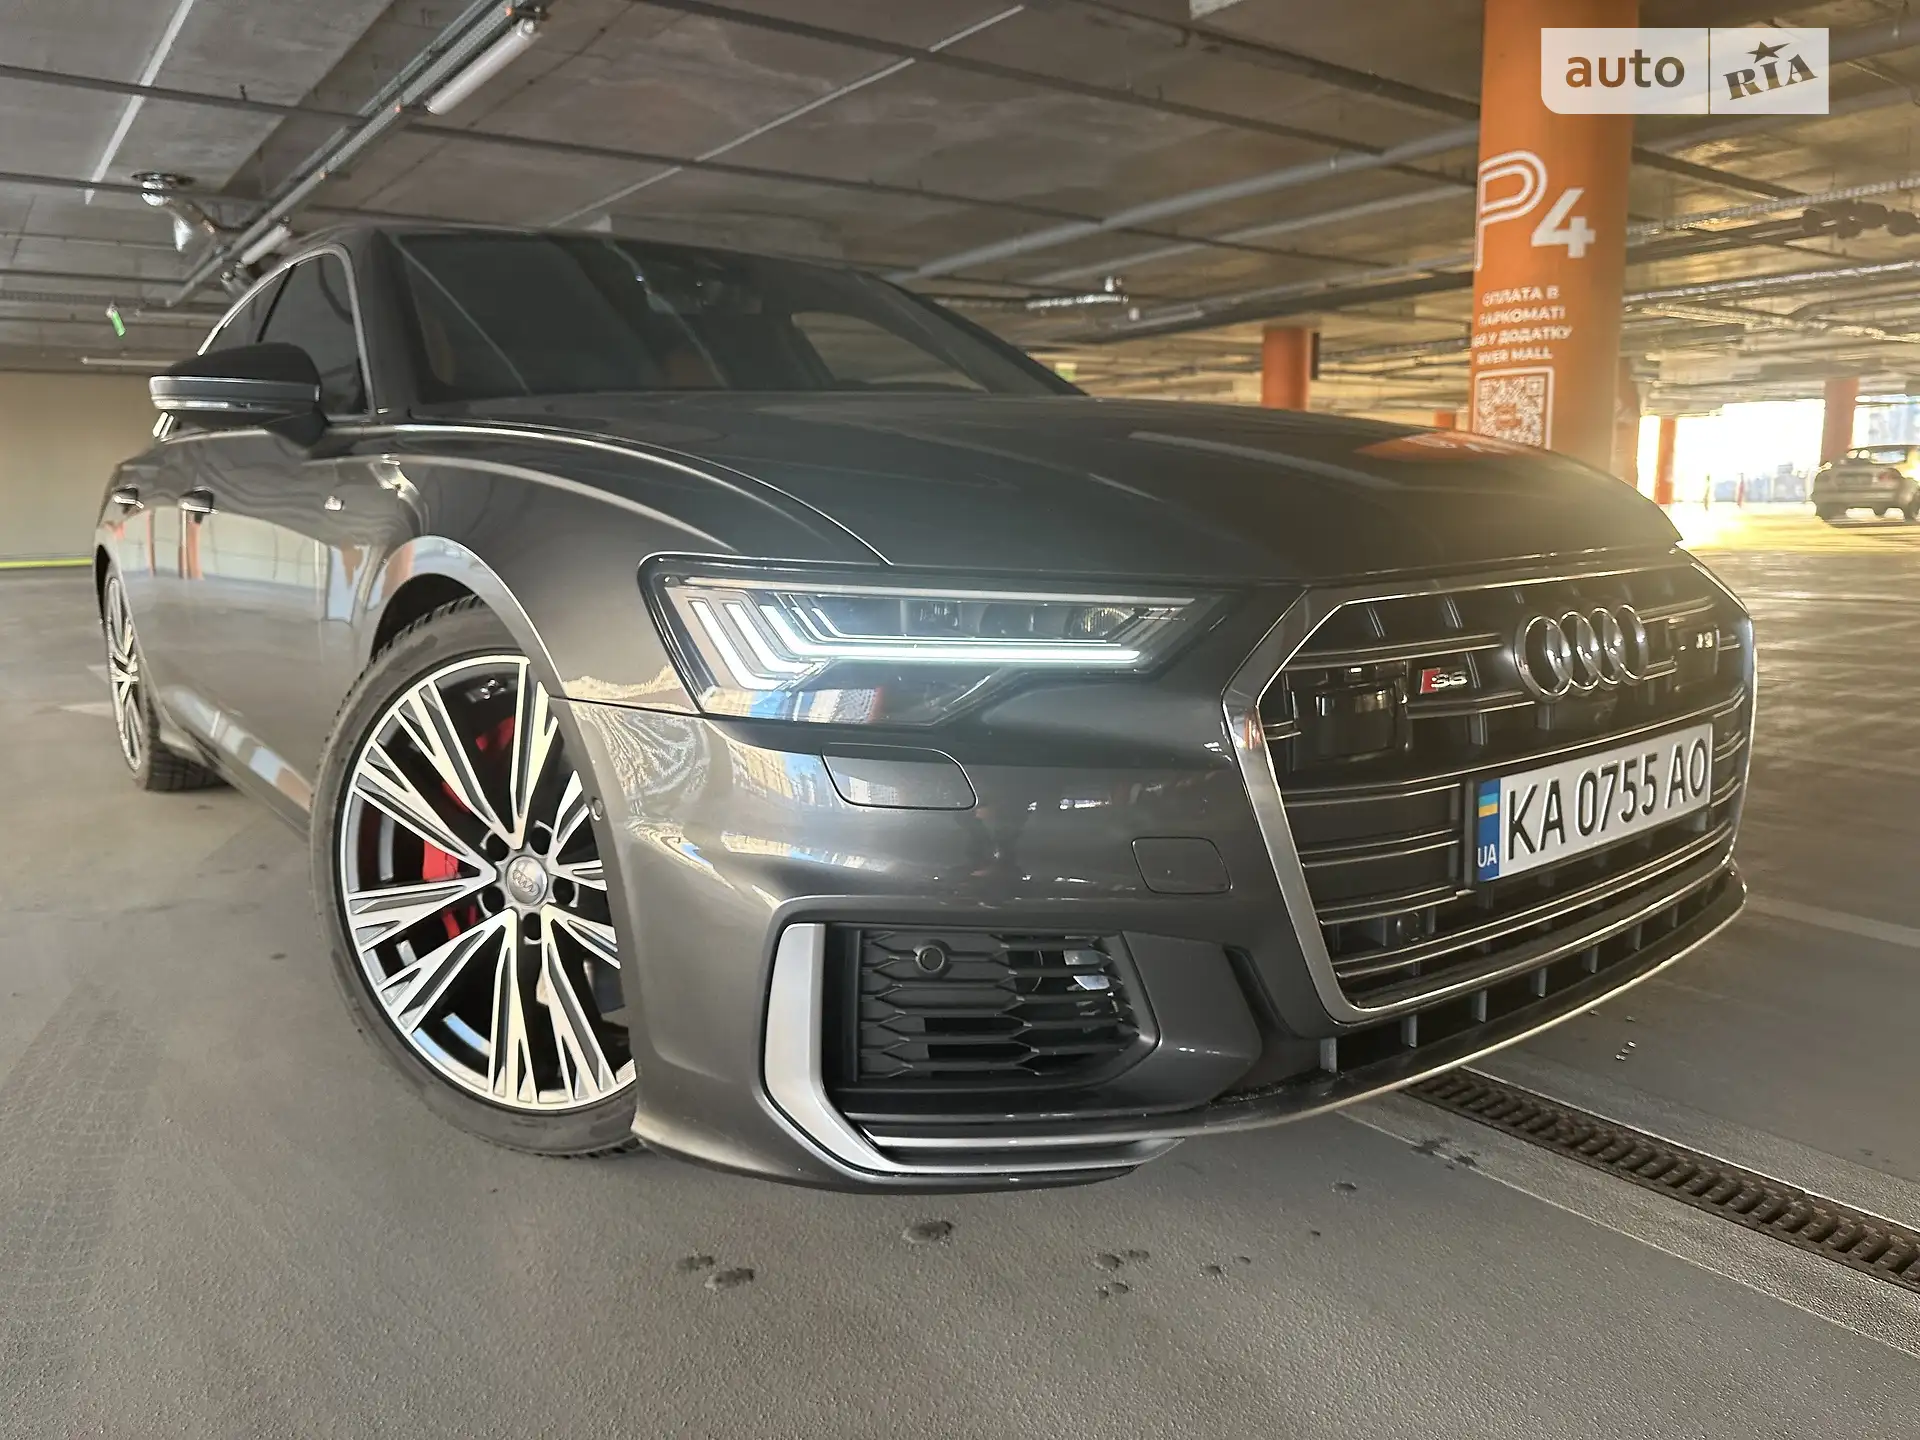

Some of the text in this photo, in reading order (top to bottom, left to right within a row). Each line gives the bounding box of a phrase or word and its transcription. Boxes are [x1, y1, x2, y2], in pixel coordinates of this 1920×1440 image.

[1511, 345, 1553, 360] MALL
[1505, 738, 1708, 863] KA 0755 AO
[1478, 844, 1497, 868] UA
